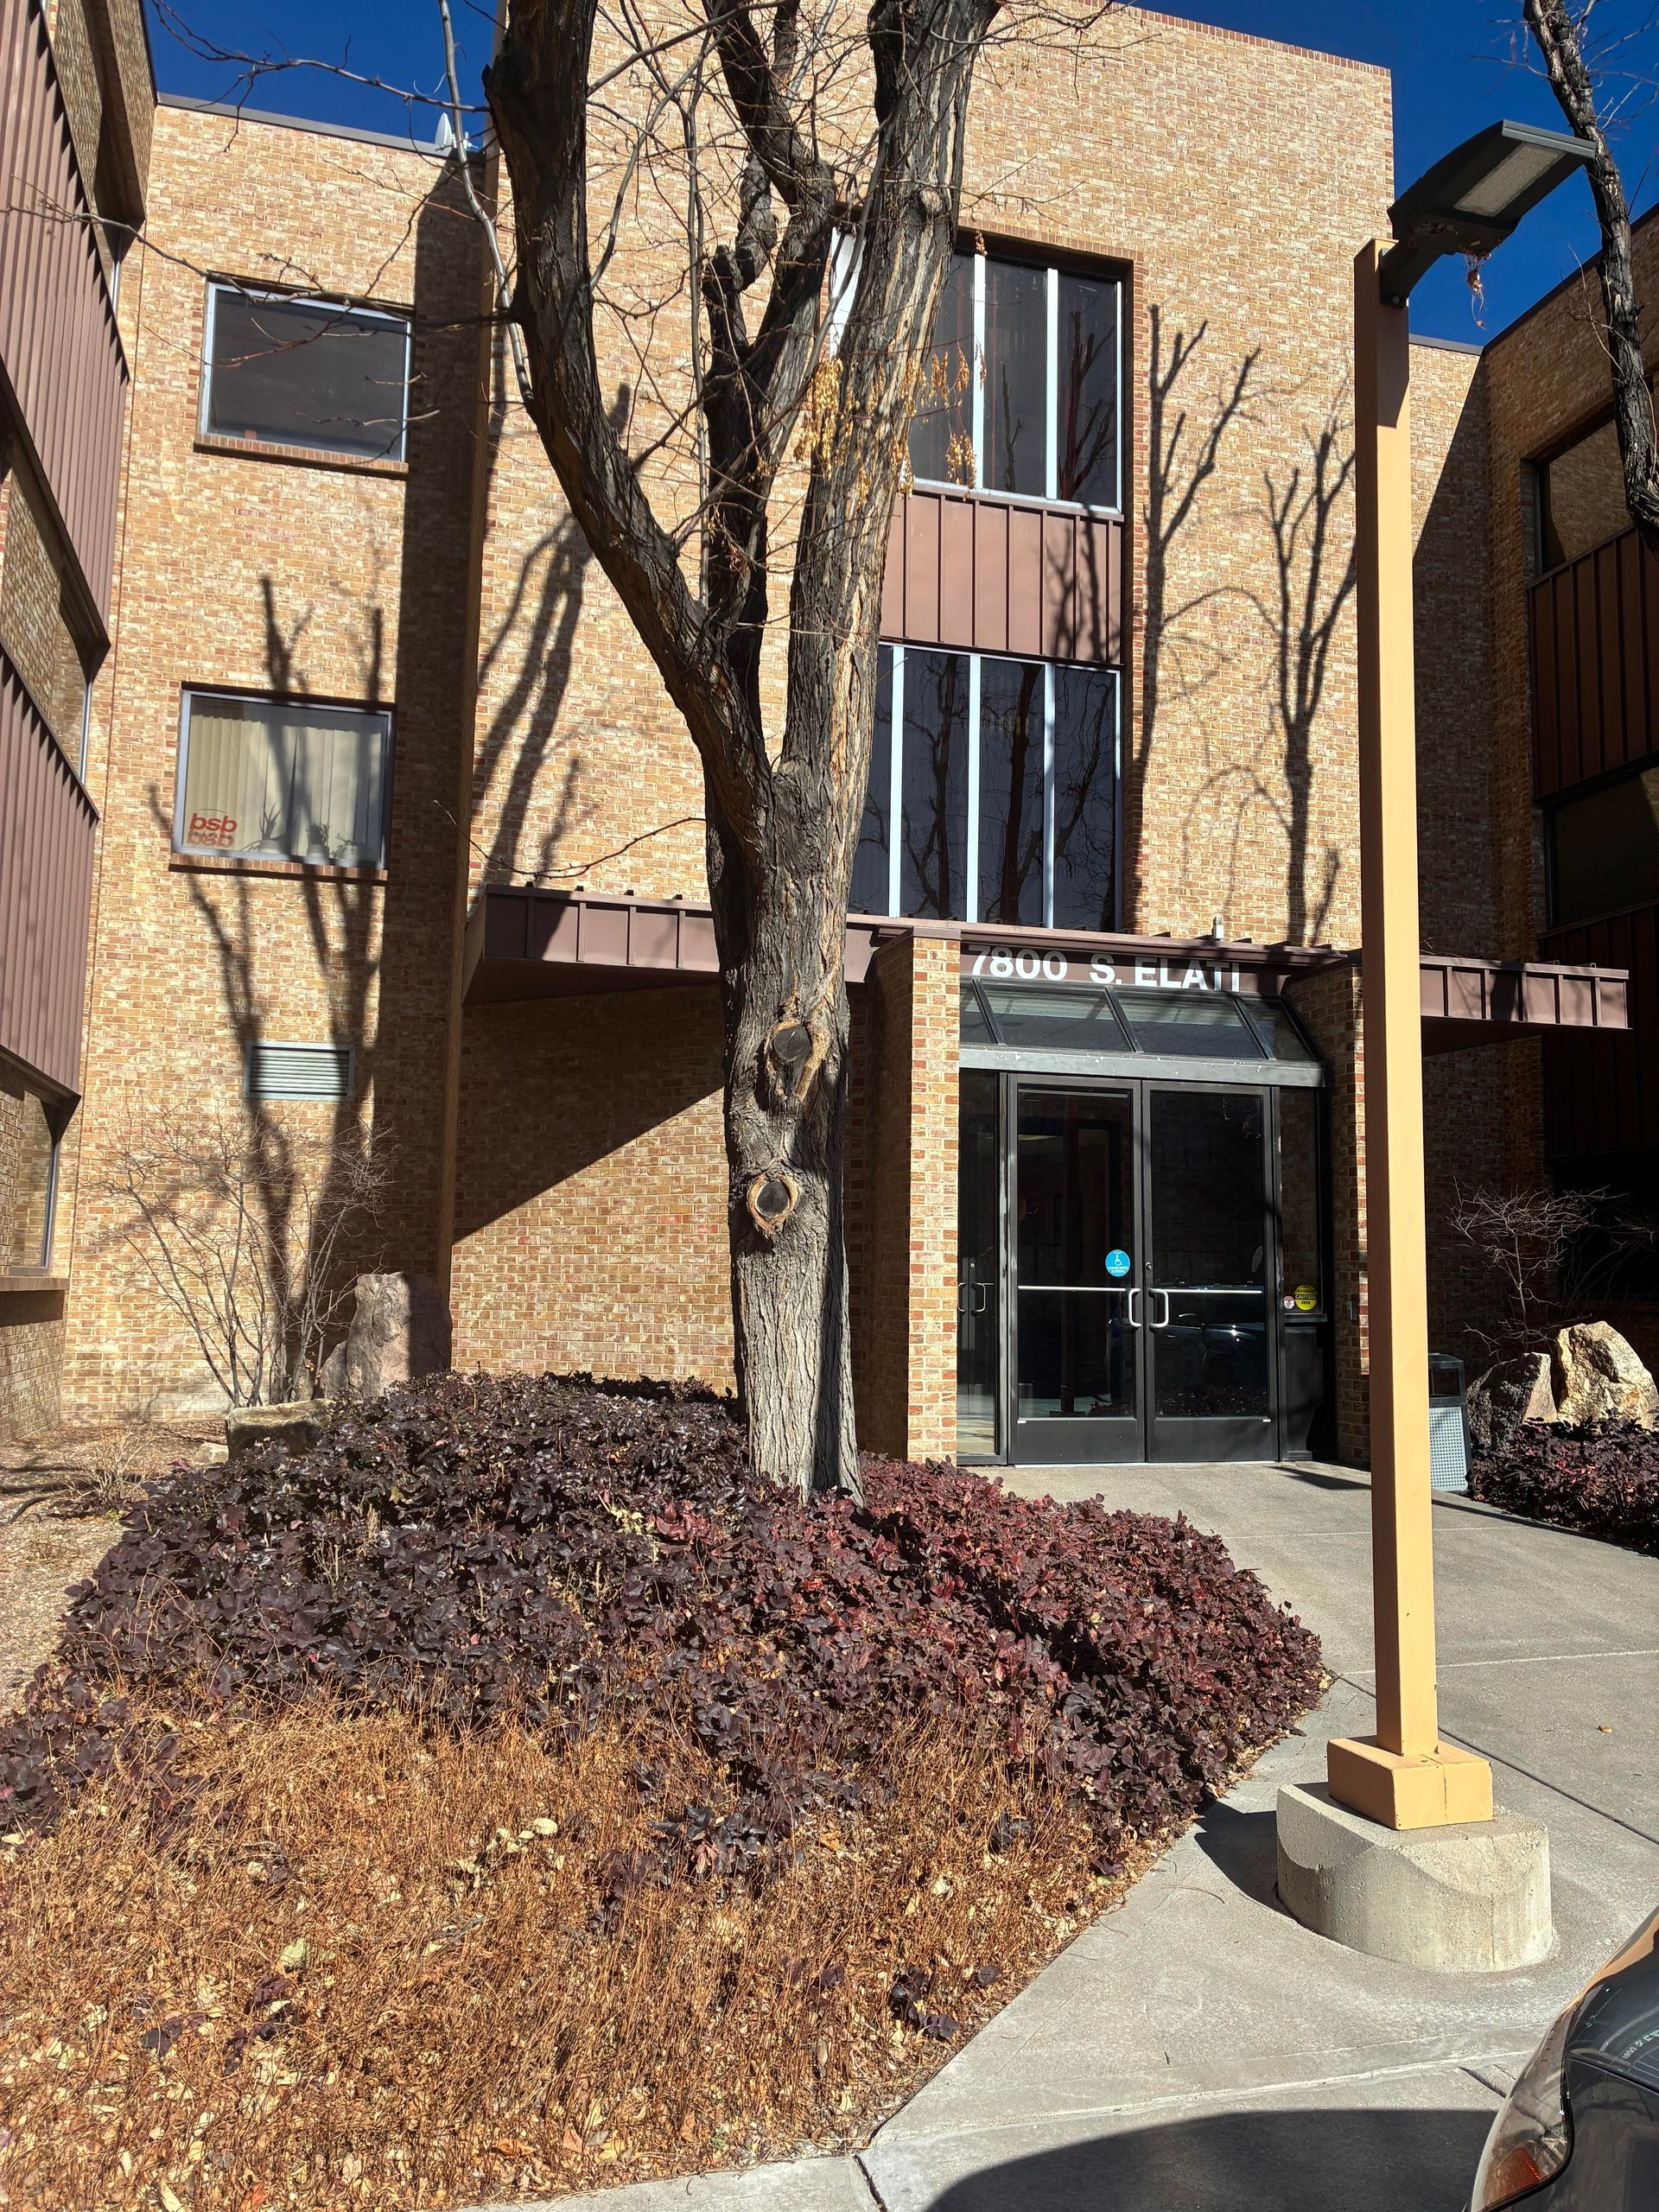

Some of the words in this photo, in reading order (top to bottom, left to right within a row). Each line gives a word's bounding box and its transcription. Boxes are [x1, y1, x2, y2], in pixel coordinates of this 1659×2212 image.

[189, 812, 238, 833] bsb
[968, 944, 1068, 982] 7800
[1089, 953, 1122, 984] S.
[1135, 957, 1240, 993] ELATI
